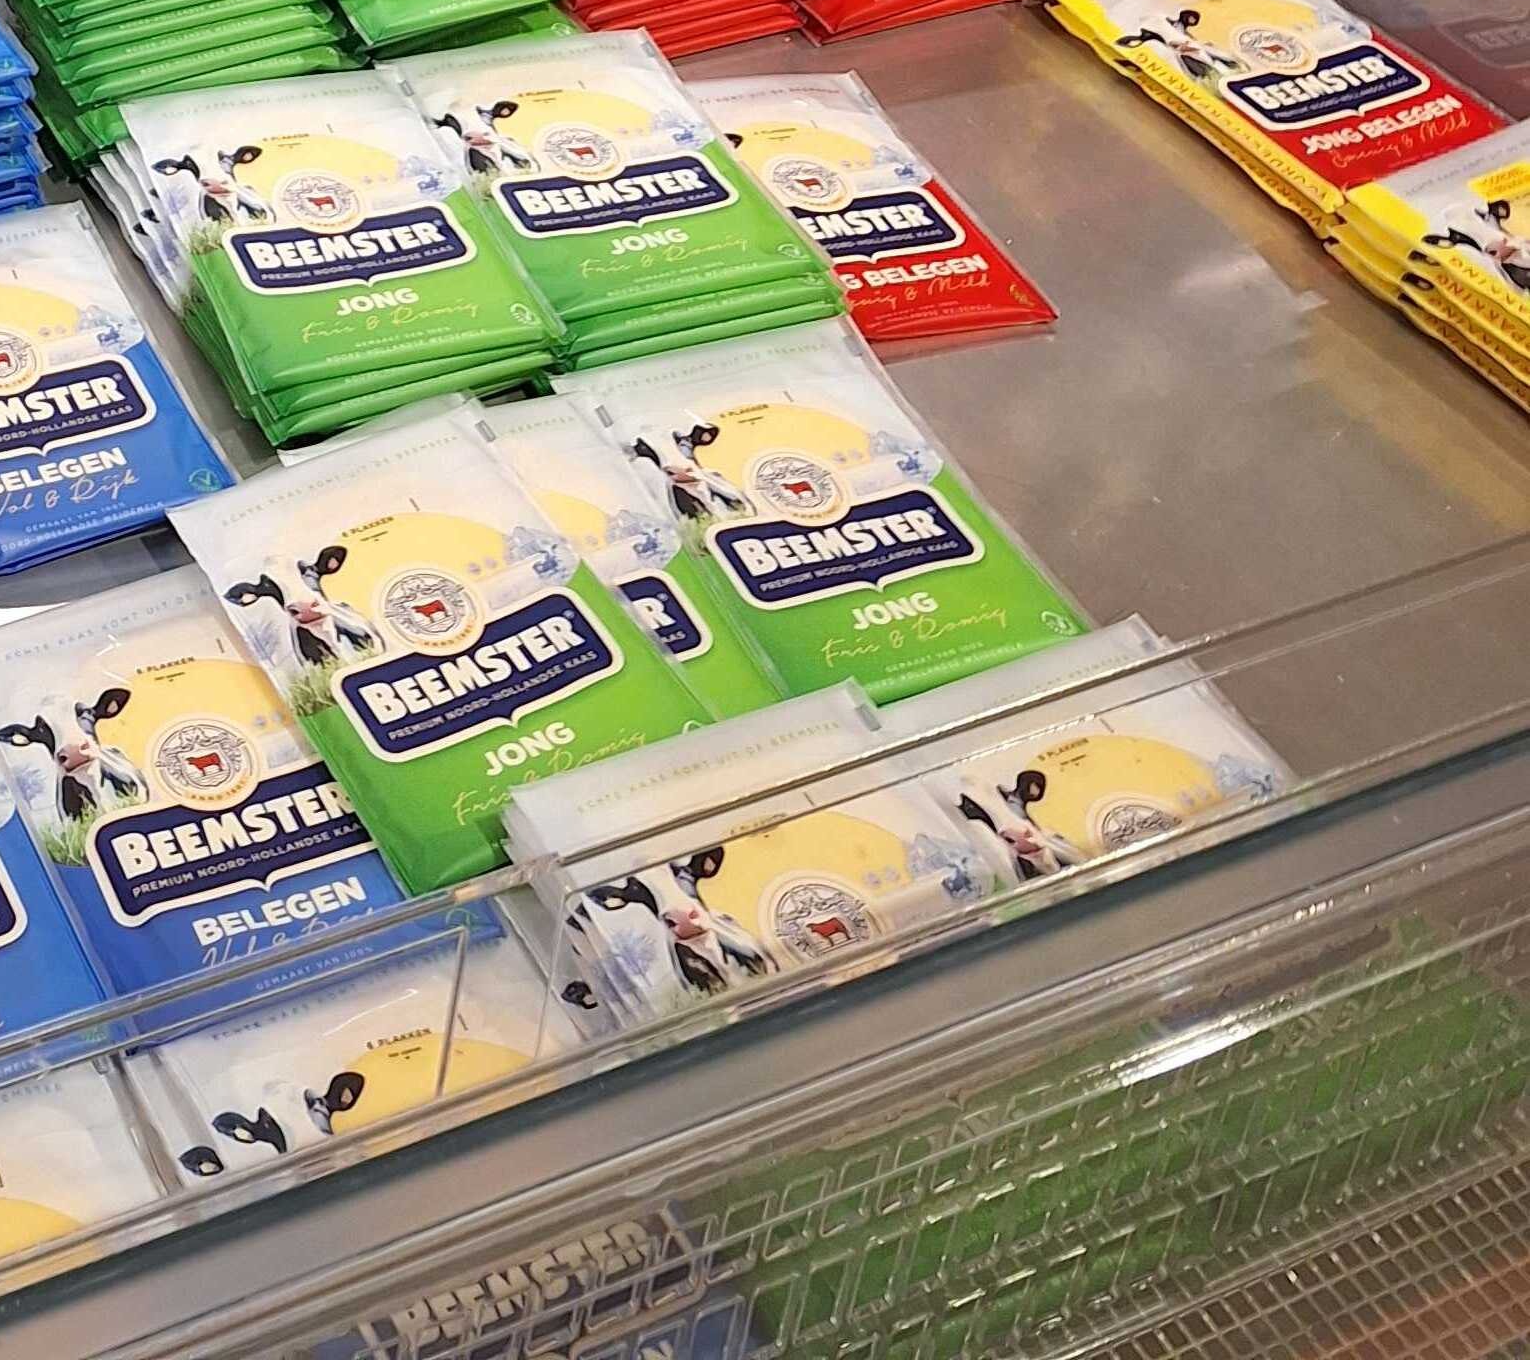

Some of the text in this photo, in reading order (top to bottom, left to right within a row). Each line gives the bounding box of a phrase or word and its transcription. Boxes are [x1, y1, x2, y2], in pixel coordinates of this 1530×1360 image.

[1244, 55, 1395, 110] BEEMSTER
[1301, 95, 1462, 155] JONG BELEGEN
[515, 168, 705, 217] BEEMSTER
[246, 221, 444, 270] BEEMSTER
[609, 225, 690, 257] JONG
[336, 286, 419, 317] JONG
[731, 509, 948, 577] BEEMSTER
[851, 592, 939, 631] JONG
[357, 615, 586, 726] BEEMSTER
[483, 721, 576, 777] JONG
[110, 781, 356, 880] BEEMSTER
[192, 875, 367, 947] BELEGEN
